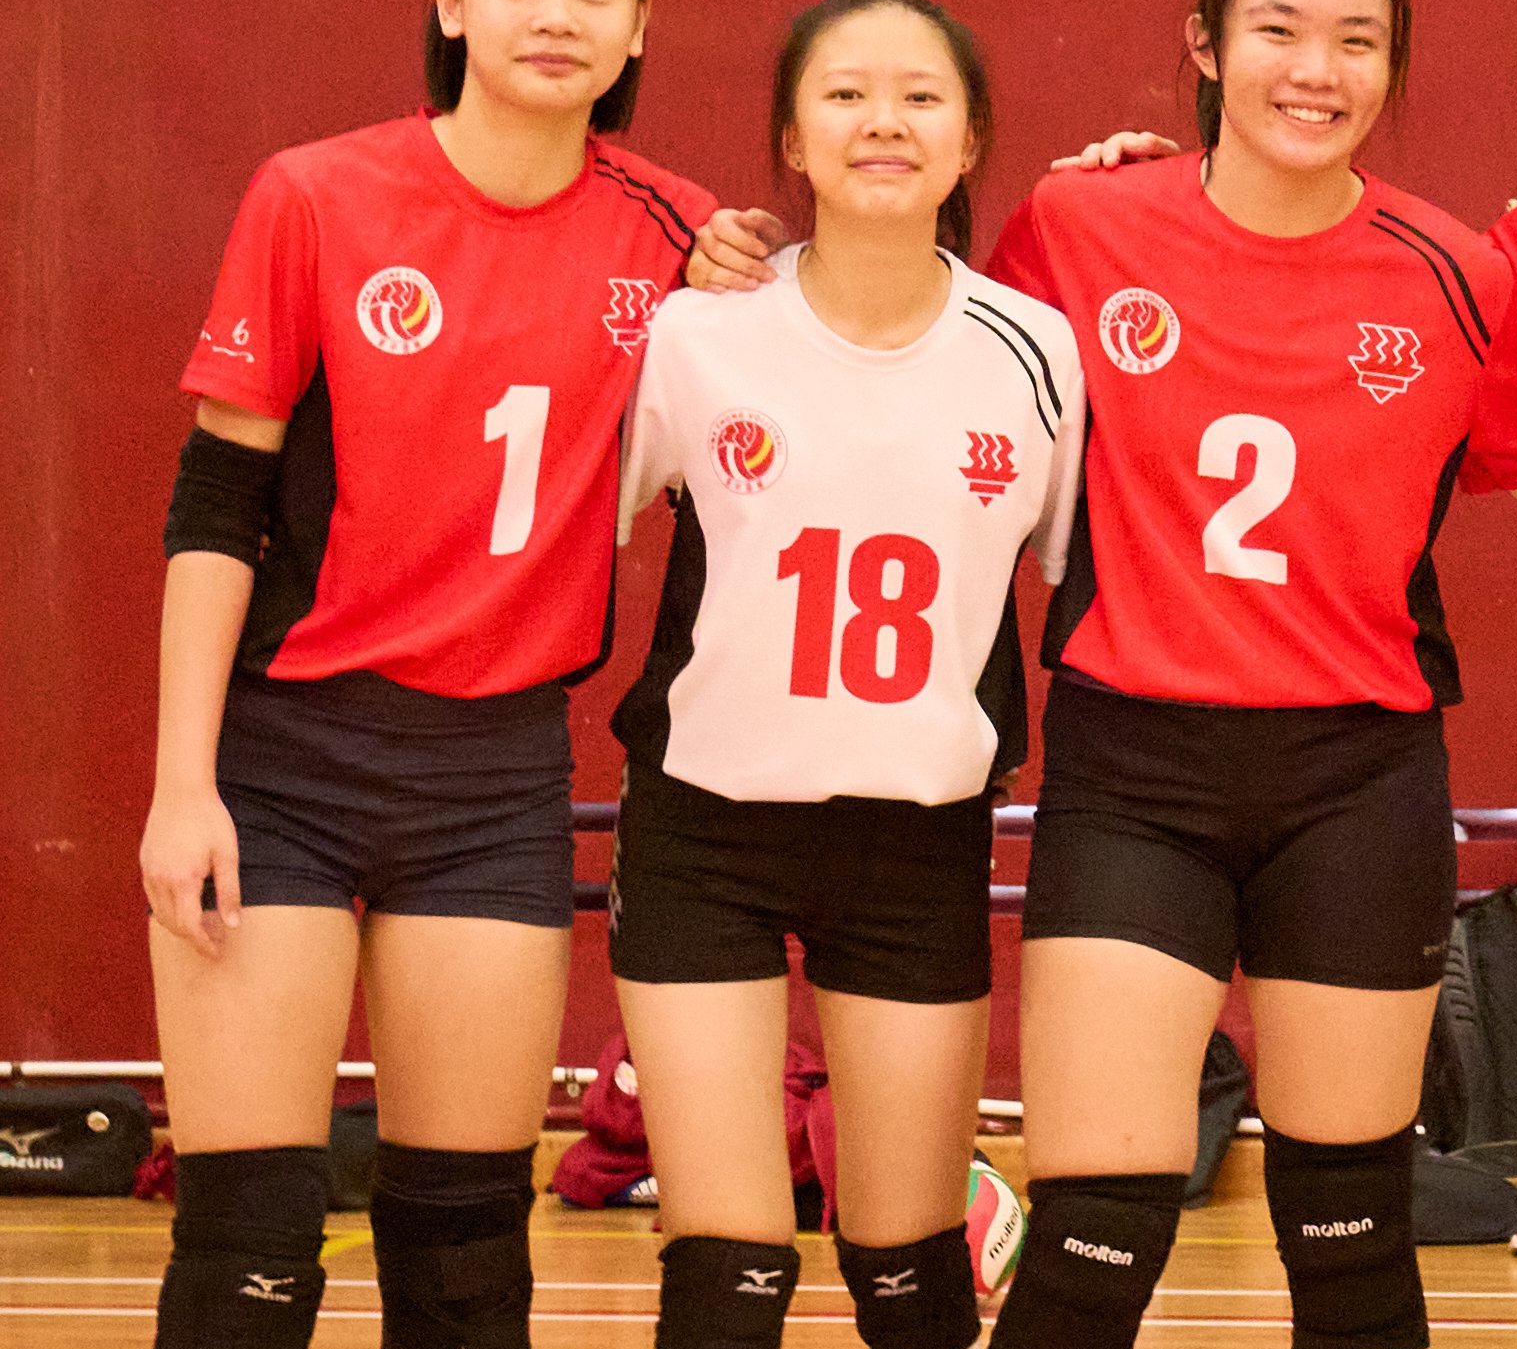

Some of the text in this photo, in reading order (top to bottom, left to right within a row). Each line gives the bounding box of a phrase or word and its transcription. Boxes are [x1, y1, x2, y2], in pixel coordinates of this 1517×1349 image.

[485, 385, 550, 555] 1
[1198, 414, 1296, 584] 2
[777, 528, 939, 703] 18
[989, 1205, 1020, 1260] molten
[1063, 1236, 1134, 1267] molten
[1302, 1217, 1373, 1239] molten
